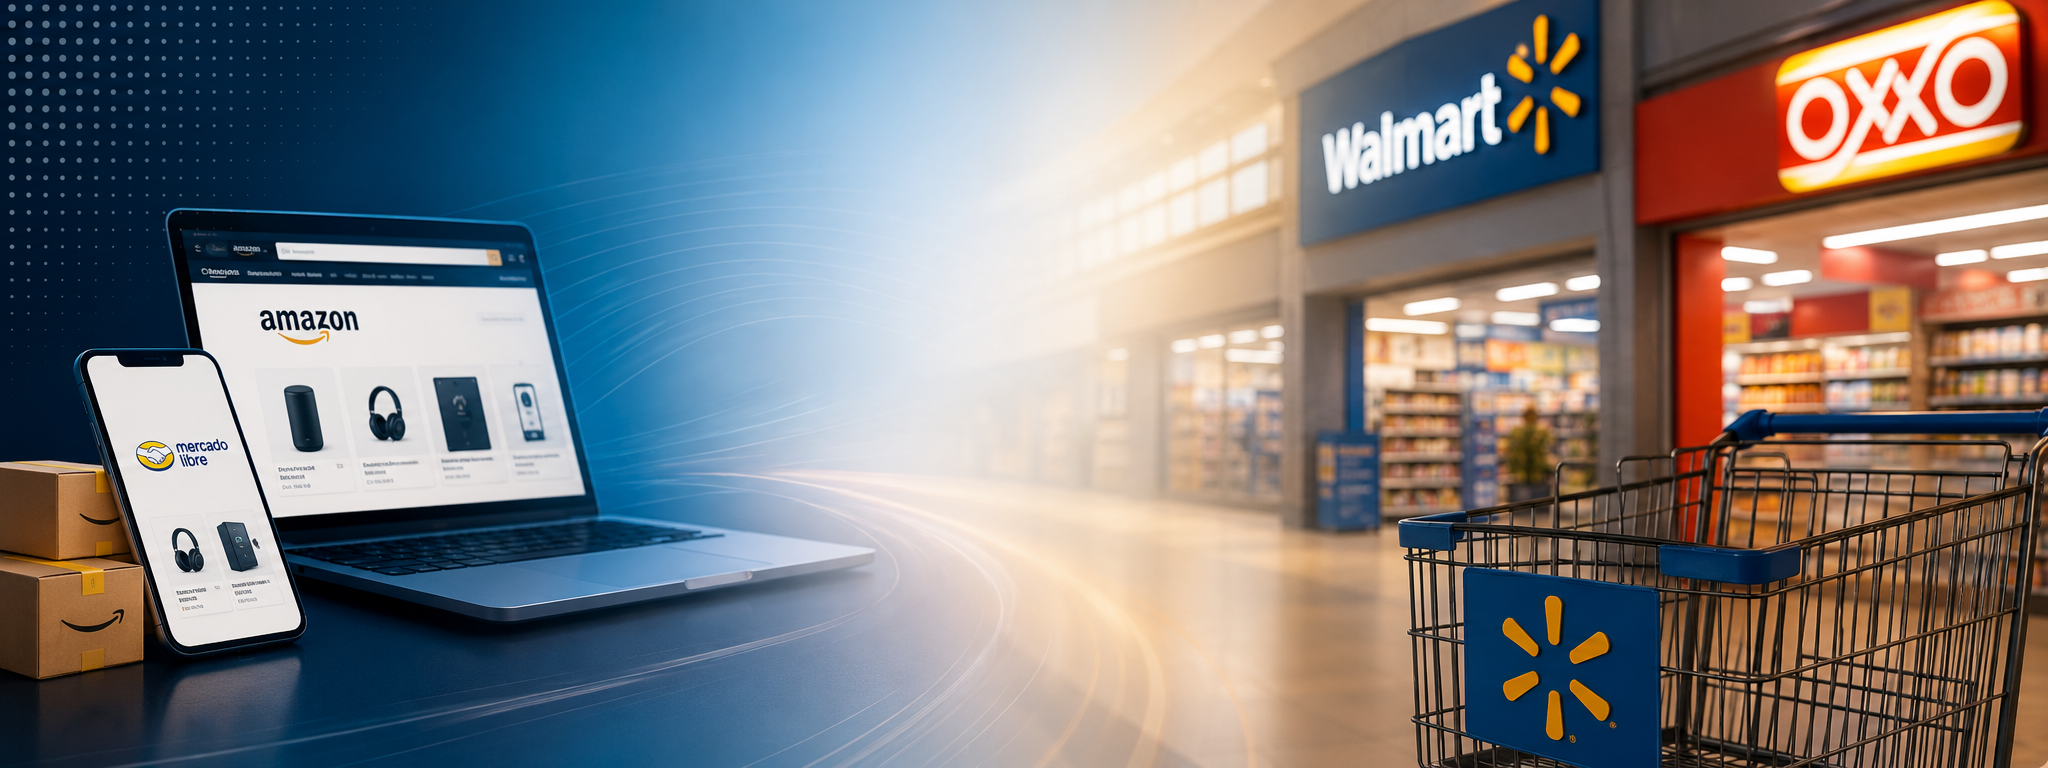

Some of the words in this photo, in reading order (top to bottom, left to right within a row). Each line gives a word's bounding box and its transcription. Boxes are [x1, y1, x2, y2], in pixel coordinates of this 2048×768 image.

[1786, 36, 2009, 162] OXXO
[1322, 72, 1502, 194] Walmart
[259, 309, 360, 331] amazon
[176, 438, 228, 453] mercado
[179, 454, 208, 467] libre
